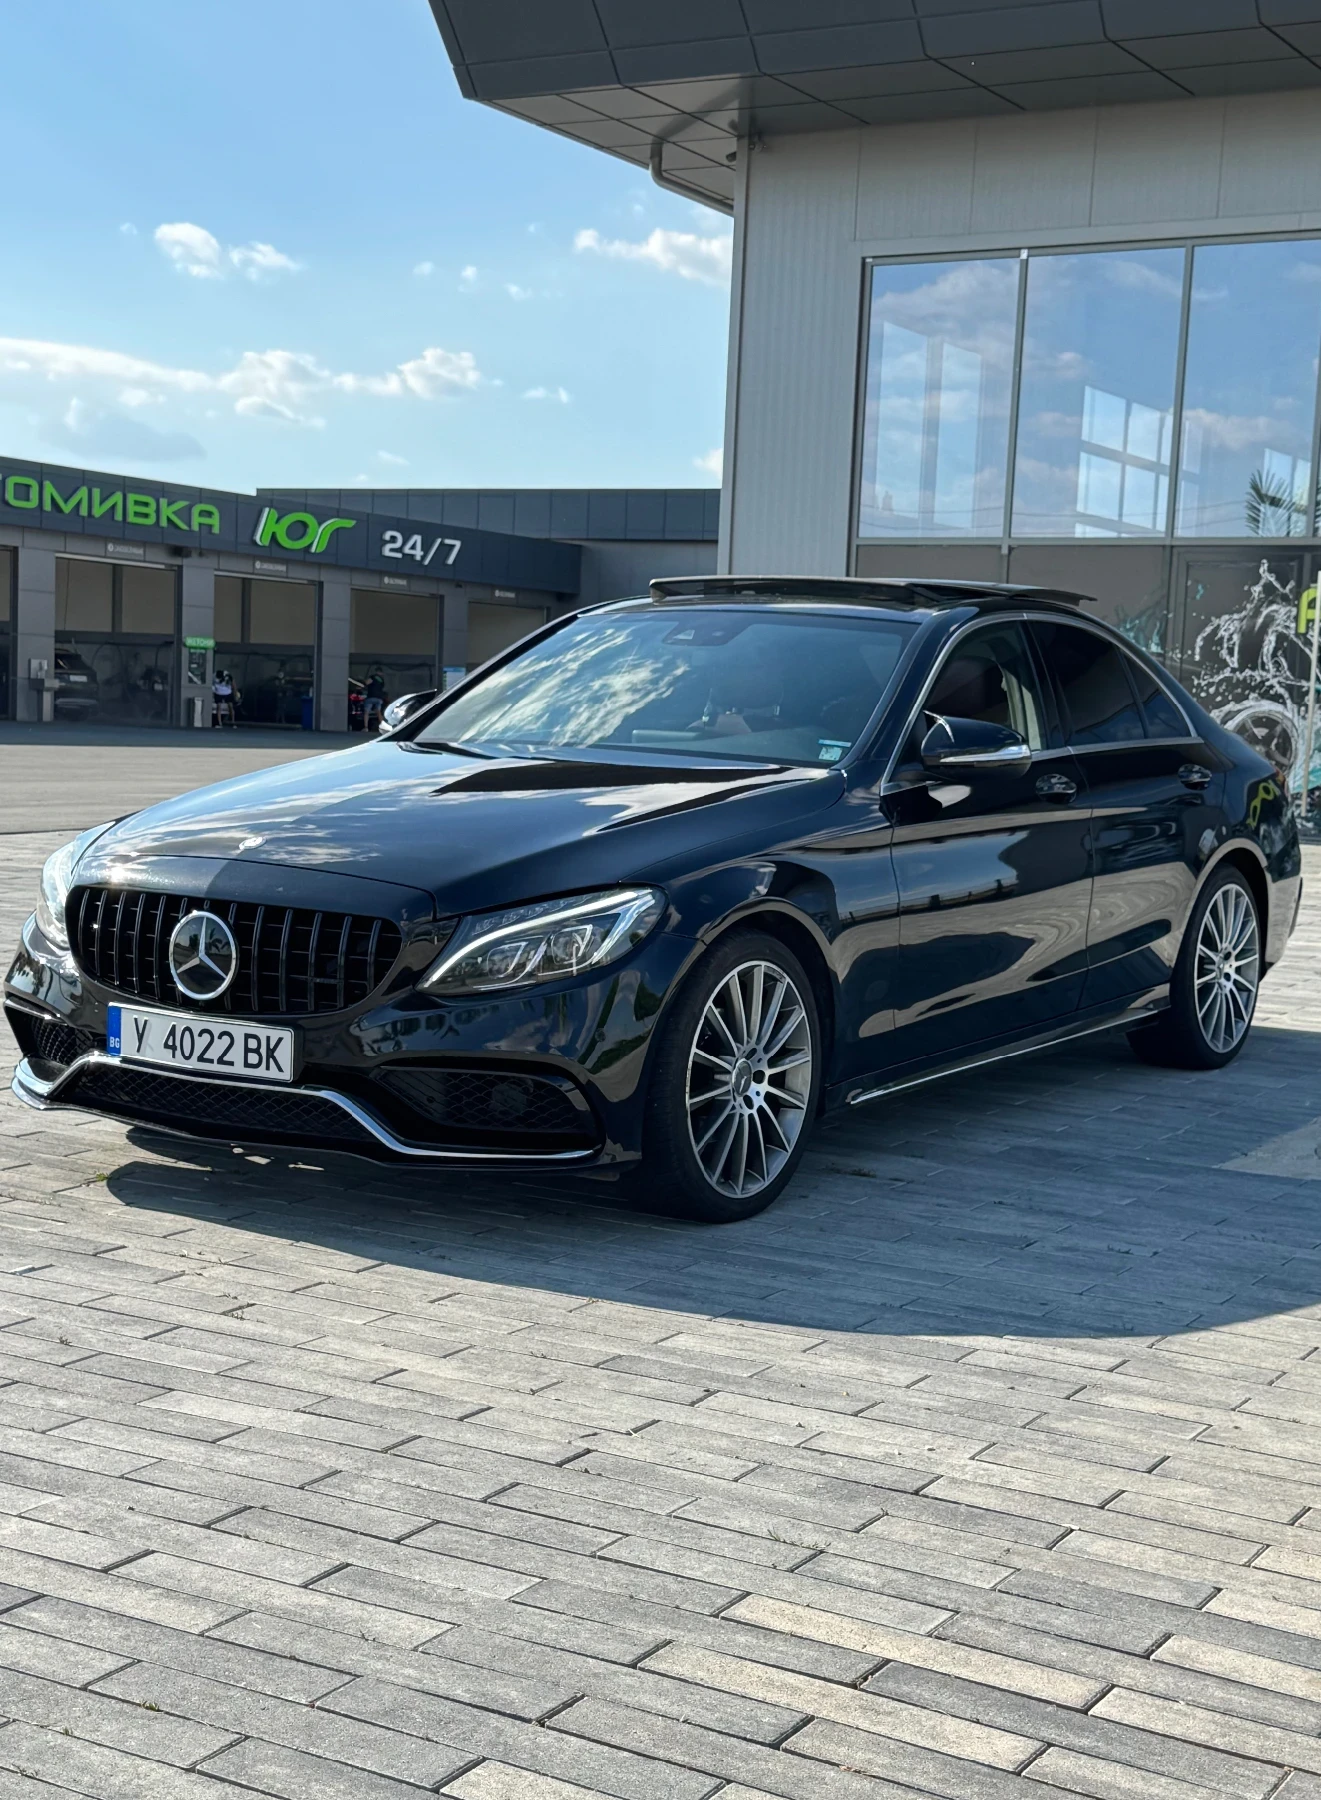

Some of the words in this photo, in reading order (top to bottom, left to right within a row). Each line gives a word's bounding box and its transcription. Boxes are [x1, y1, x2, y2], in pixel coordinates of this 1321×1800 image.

[0, 474, 220, 534] ОМИВКА
[381, 530, 462, 566] 24/7
[109, 1036, 120, 1049] BG
